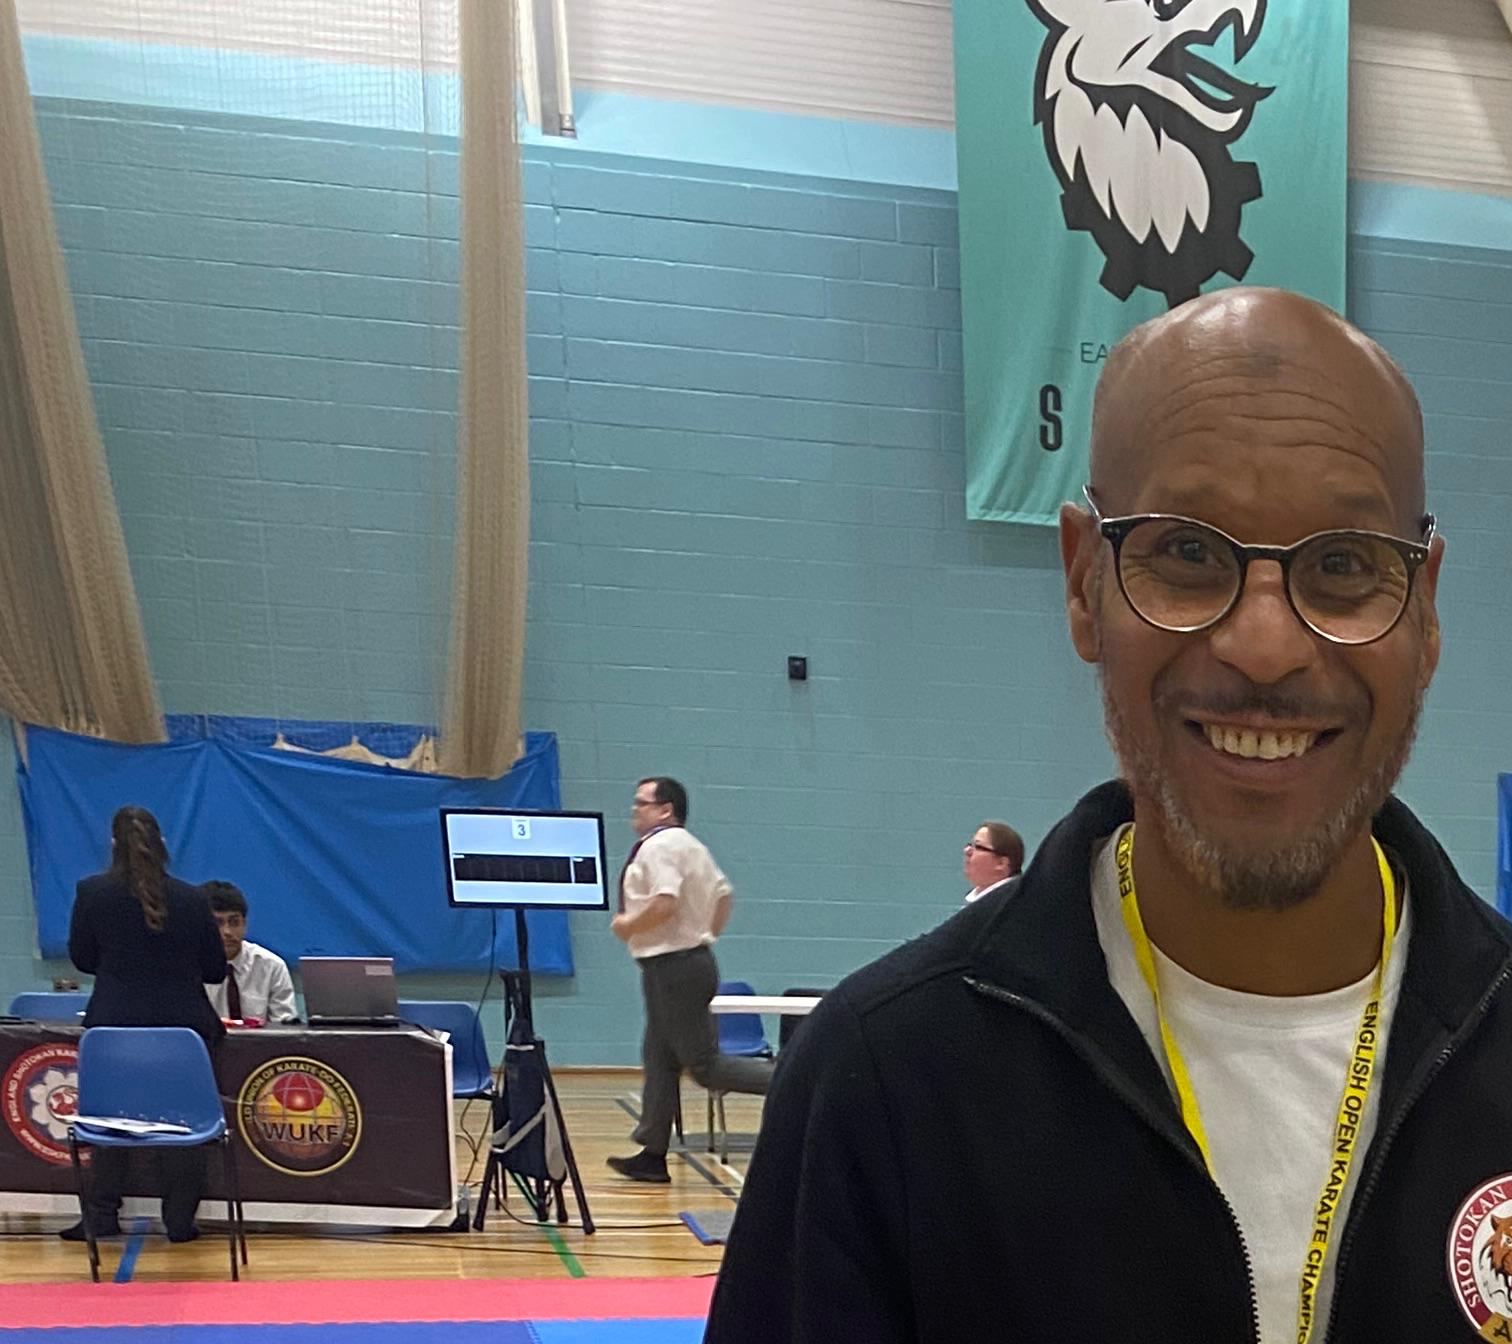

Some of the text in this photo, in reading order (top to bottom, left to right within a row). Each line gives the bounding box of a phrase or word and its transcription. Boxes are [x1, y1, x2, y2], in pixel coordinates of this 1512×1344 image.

[518, 824, 526, 836] 3
[1350, 1000, 1379, 1092] ENGLISH
[262, 1122, 340, 1143] WUKF
[1335, 1095, 1362, 1154] OPEN
[1311, 1159, 1348, 1243] KARATE
[1456, 1186, 1507, 1308] SHOTOKAN
